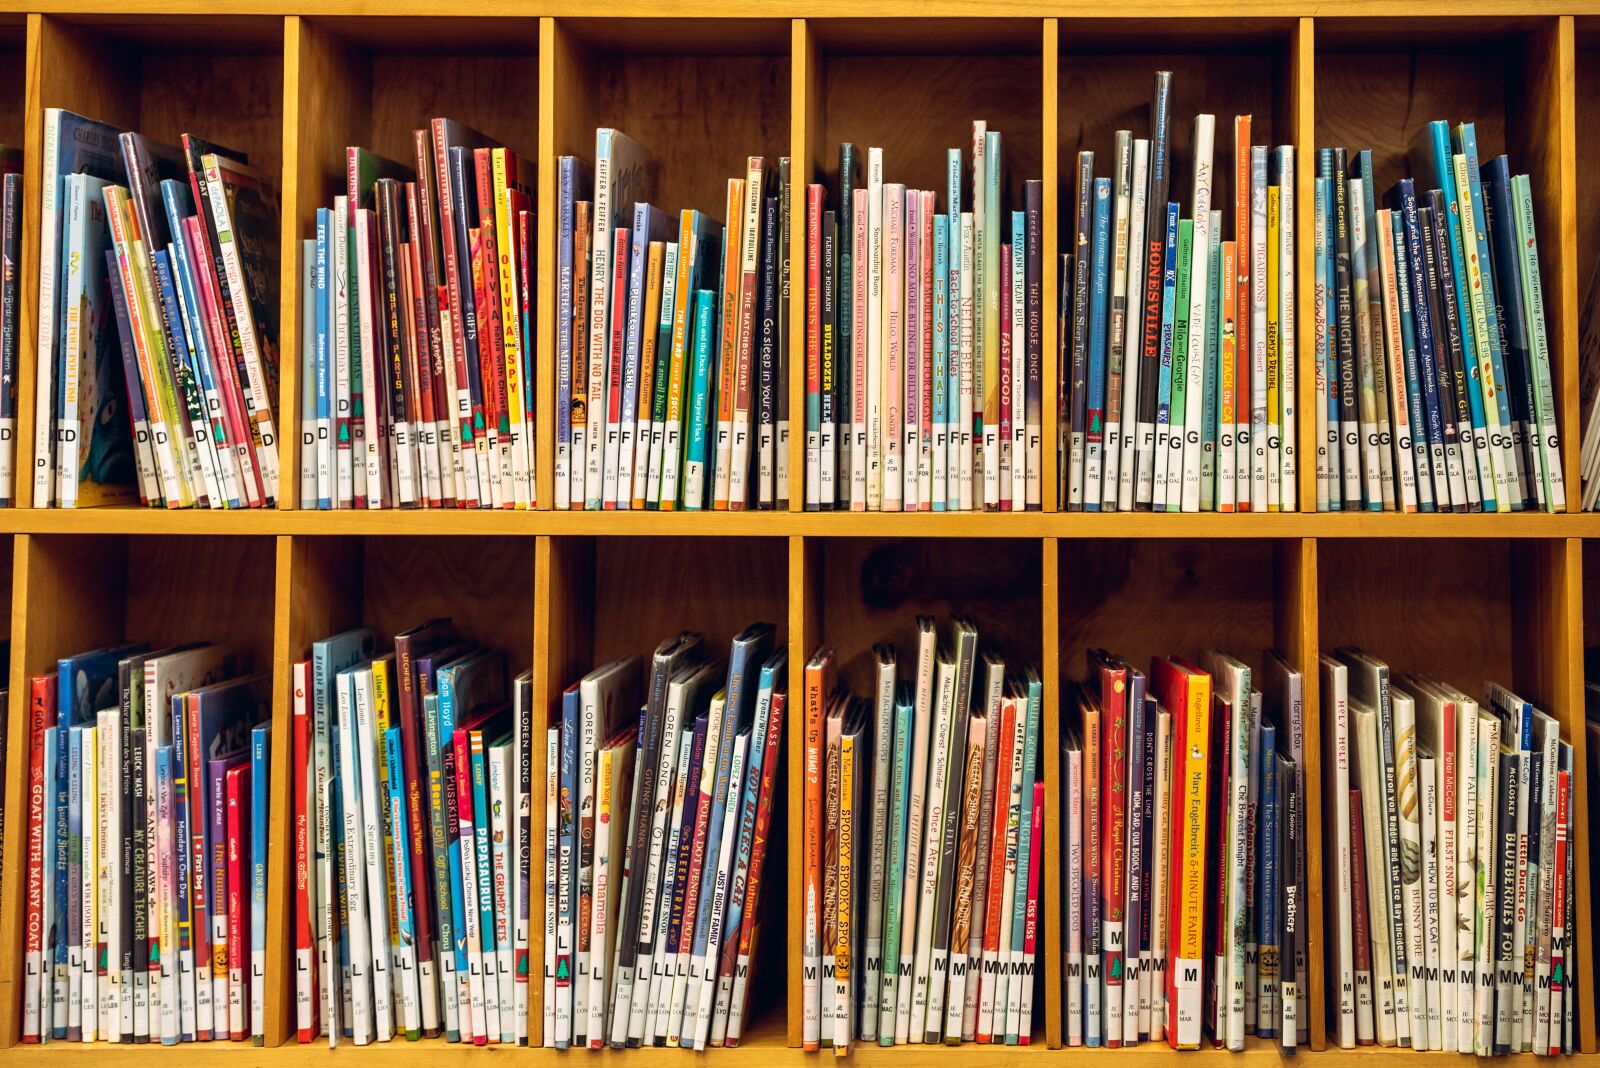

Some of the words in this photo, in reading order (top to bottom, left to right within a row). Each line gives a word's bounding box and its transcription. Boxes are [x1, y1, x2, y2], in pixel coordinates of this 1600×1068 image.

[598, 202, 606, 232] FEIFFER
[871, 227, 880, 274] Snowboarding
[596, 250, 605, 283] HENRY
[1256, 243, 1265, 302] PIGAROONS
[595, 287, 604, 306] THE
[783, 280, 791, 299] No!
[871, 276, 880, 296] Bunny
[1030, 282, 1038, 305] THIS
[1145, 241, 1162, 357] BONESVILLE
[1339, 286, 1349, 309] THE
[4, 296, 13, 317] Birds
[594, 310, 604, 330] DOG
[629, 288, 639, 338] Plankton
[700, 305, 708, 326] Angus
[949, 270, 959, 345] Back-to-School
[501, 255, 513, 335] OLIVIA
[507, 355, 516, 393] SPY
[561, 318, 567, 326] IN
[961, 297, 971, 346] NELLIE
[1177, 319, 1186, 339] Milo
[1340, 314, 1351, 355] NIGHT
[4, 326, 12, 369] Bethlehem
[224, 301, 246, 371] HALLOWEEN
[560, 330, 568, 347] THE
[593, 333, 603, 360] WITH
[741, 312, 751, 361] MATCHBOX
[1002, 333, 1010, 363] FAST
[645, 339, 653, 369] Kitten's
[698, 355, 706, 376] Ducks
[950, 350, 958, 377] Rules
[1030, 354, 1038, 381] ONCE
[560, 349, 568, 390] MIDDLE
[625, 354, 636, 388] PUSHY
[740, 364, 748, 391] DIARY
[961, 352, 971, 395] BELLE
[1175, 355, 1185, 392] Georgie
[1268, 360, 1277, 390] DREIDEL
[1342, 357, 1353, 406] WORLD
[592, 380, 602, 401] TAIL
[642, 372, 651, 404] Autumn
[1002, 367, 1010, 405] FOOD
[1, 429, 11, 440] D
[66, 430, 75, 441] D
[304, 433, 314, 444] D
[574, 433, 582, 444] F
[737, 432, 745, 444] F
[822, 434, 830, 446] F
[987, 434, 994, 446] F
[1187, 431, 1198, 443] G
[1347, 433, 1357, 444] G
[1548, 435, 1559, 447] G
[1194, 692, 1203, 732] Engelbreit
[428, 710, 437, 755] Livingston
[1016, 723, 1024, 742] Jeff
[1014, 748, 1022, 772] Mack
[135, 778, 143, 797] NASH
[1191, 772, 1201, 796] Mary
[1386, 768, 1395, 793] Baron
[1507, 768, 1516, 816] McCLOSKEY
[32, 785, 42, 819] GOAT
[147, 811, 156, 849] SANTA
[346, 812, 355, 825] An
[698, 800, 709, 836] POLKA
[1189, 800, 1201, 858] Engelbreit's
[1389, 816, 1398, 844] Baddie
[32, 826, 41, 862] WITH
[135, 830, 144, 842] MY
[177, 821, 185, 851] Monday
[840, 810, 851, 859] SPOOKY
[1132, 832, 1140, 846] OUR
[1445, 830, 1453, 862] FIRST
[346, 827, 357, 890] Extraordinary
[495, 853, 504, 870] THE
[694, 840, 705, 864] DOT
[1391, 848, 1399, 862] and
[1518, 834, 1527, 866] Little
[135, 848, 144, 893] CREATURE
[147, 853, 156, 893] CLAWS
[178, 864, 186, 879] One
[477, 828, 490, 912] PAPASAURUS
[559, 846, 570, 912] DRUMMER
[717, 870, 726, 890] JUST
[1131, 876, 1139, 890] AND
[1446, 866, 1454, 897] SNOW
[1503, 833, 1515, 925] BLUEBERRIES
[30, 868, 41, 906] MANY
[177, 883, 186, 899] Day
[496, 873, 505, 915] GRUMPY
[687, 868, 701, 917] PENGUIN
[839, 865, 849, 915] SPOOKY
[1131, 893, 1138, 902] ME
[1188, 860, 1199, 912] 5-MINUTE
[1393, 885, 1401, 900] Ice
[1518, 870, 1526, 905] Ducks
[349, 893, 359, 912] Egg
[596, 874, 607, 935] Chamelia
[713, 893, 724, 916] RIGHT
[1286, 886, 1296, 932] Brothers
[1393, 904, 1402, 920] Ray
[1517, 908, 1526, 922] Go
[135, 900, 145, 940] TEACHER
[498, 919, 506, 941] PETS
[710, 919, 720, 945] FAMILY
[1187, 915, 1197, 947] FAIRY
[1395, 923, 1405, 961] Incident
[1501, 931, 1513, 962] FOR
[28, 963, 36, 975] L
[298, 959, 306, 970] L
[594, 967, 602, 979] L
[804, 966, 815, 979] M
[900, 964, 911, 976] M
[1185, 969, 1197, 981] M
[1412, 966, 1423, 979] M
[837, 986, 845, 994] M
